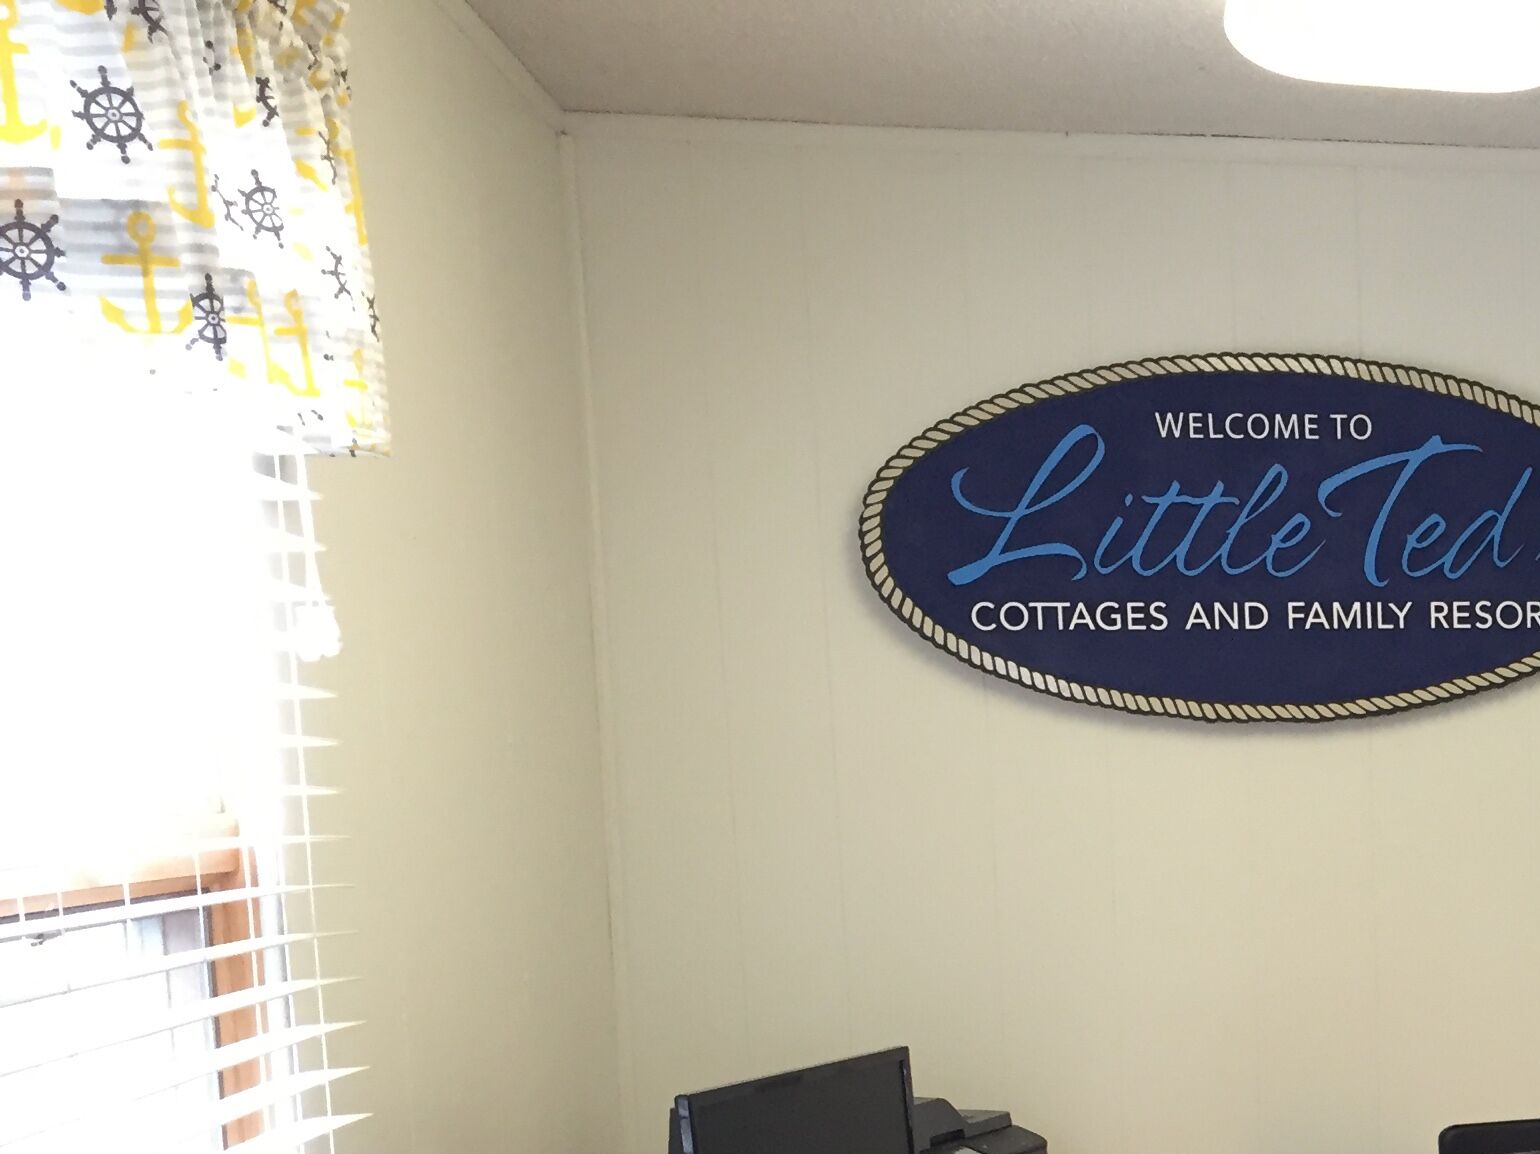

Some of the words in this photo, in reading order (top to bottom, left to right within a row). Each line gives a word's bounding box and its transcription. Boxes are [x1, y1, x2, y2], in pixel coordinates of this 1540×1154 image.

[1154, 411, 1320, 440] WELCOME
[1329, 413, 1372, 440] TO
[947, 423, 1326, 588] Little
[970, 601, 1169, 632] COTTAGES
[1184, 601, 1269, 631] AND
[1287, 600, 1413, 631] FAMILY
